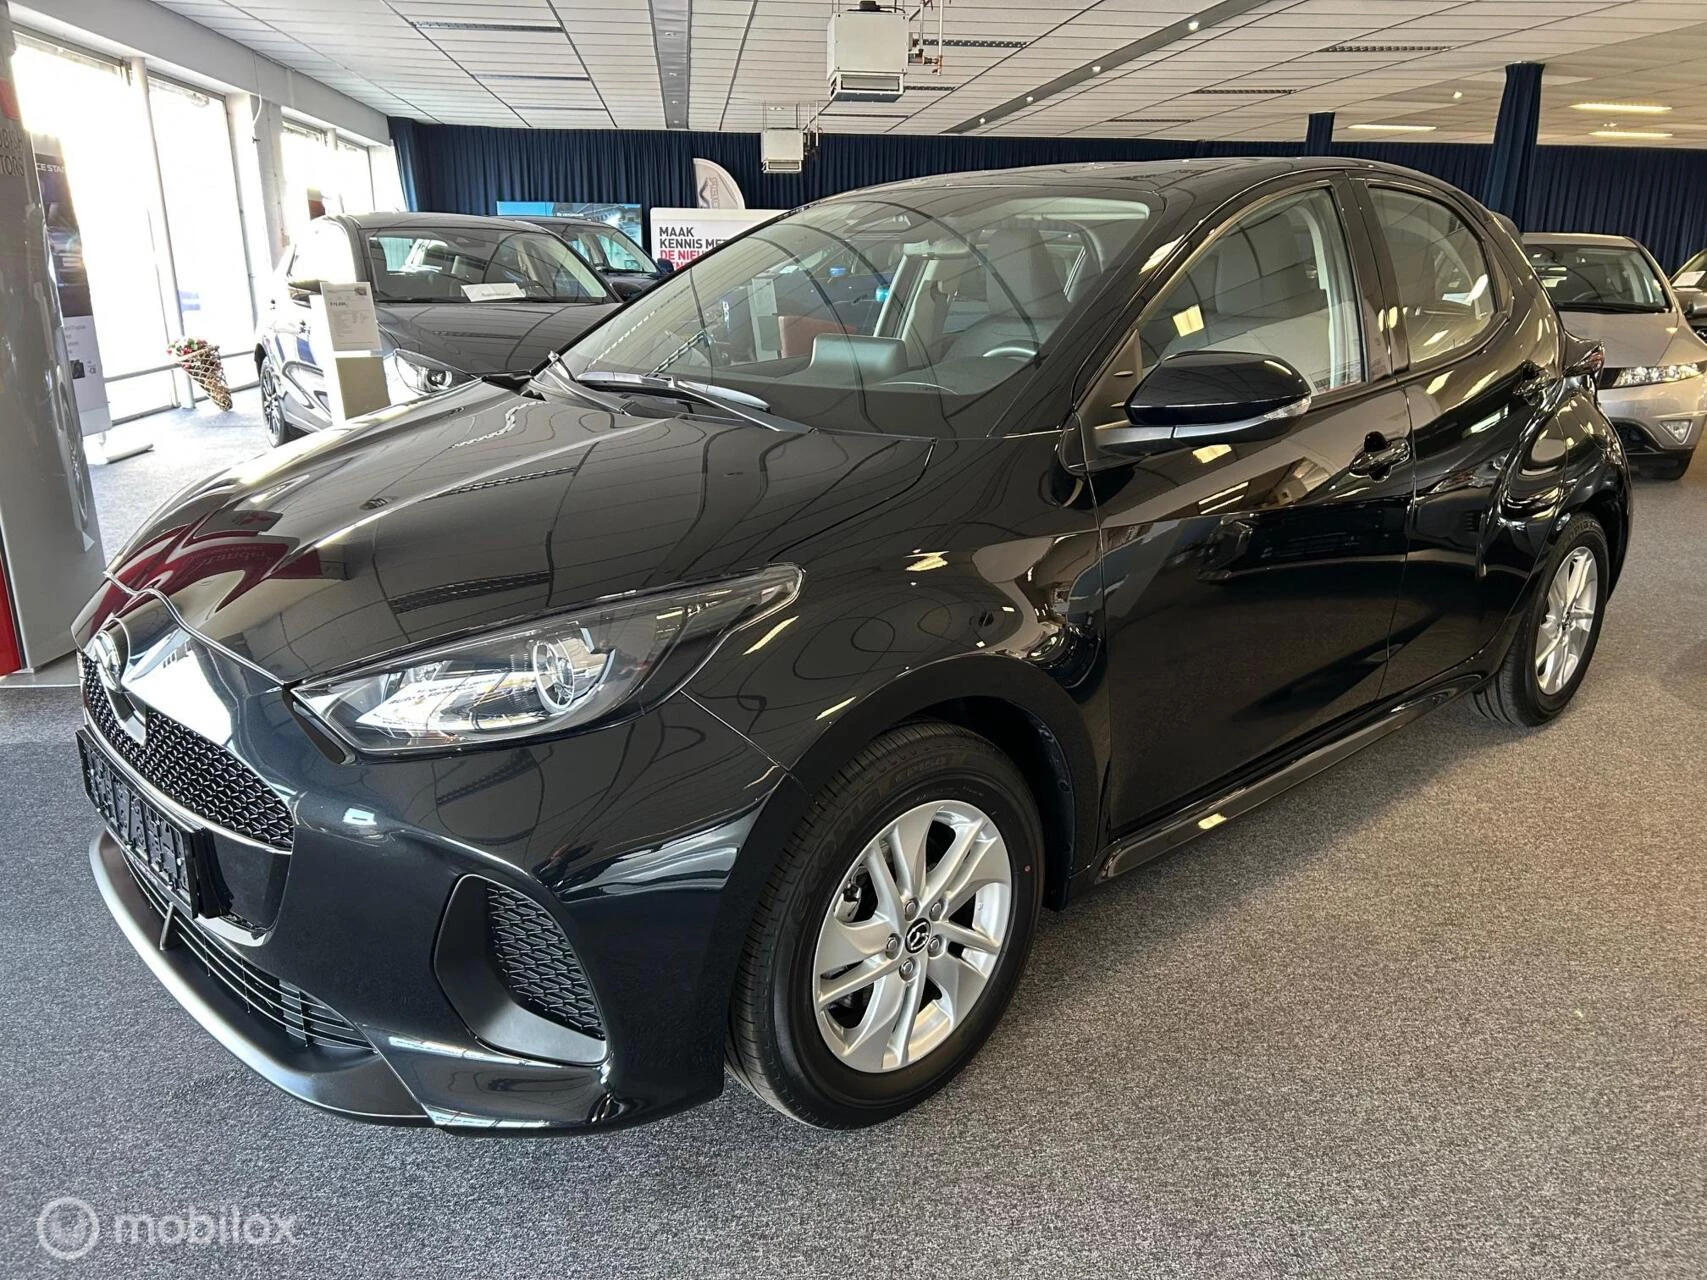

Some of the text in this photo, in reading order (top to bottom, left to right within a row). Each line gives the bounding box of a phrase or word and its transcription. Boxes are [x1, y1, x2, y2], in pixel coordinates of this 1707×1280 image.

[659, 227, 694, 237] MAAK
[660, 239, 703, 249] KENNIS
[660, 250, 675, 260] DE
